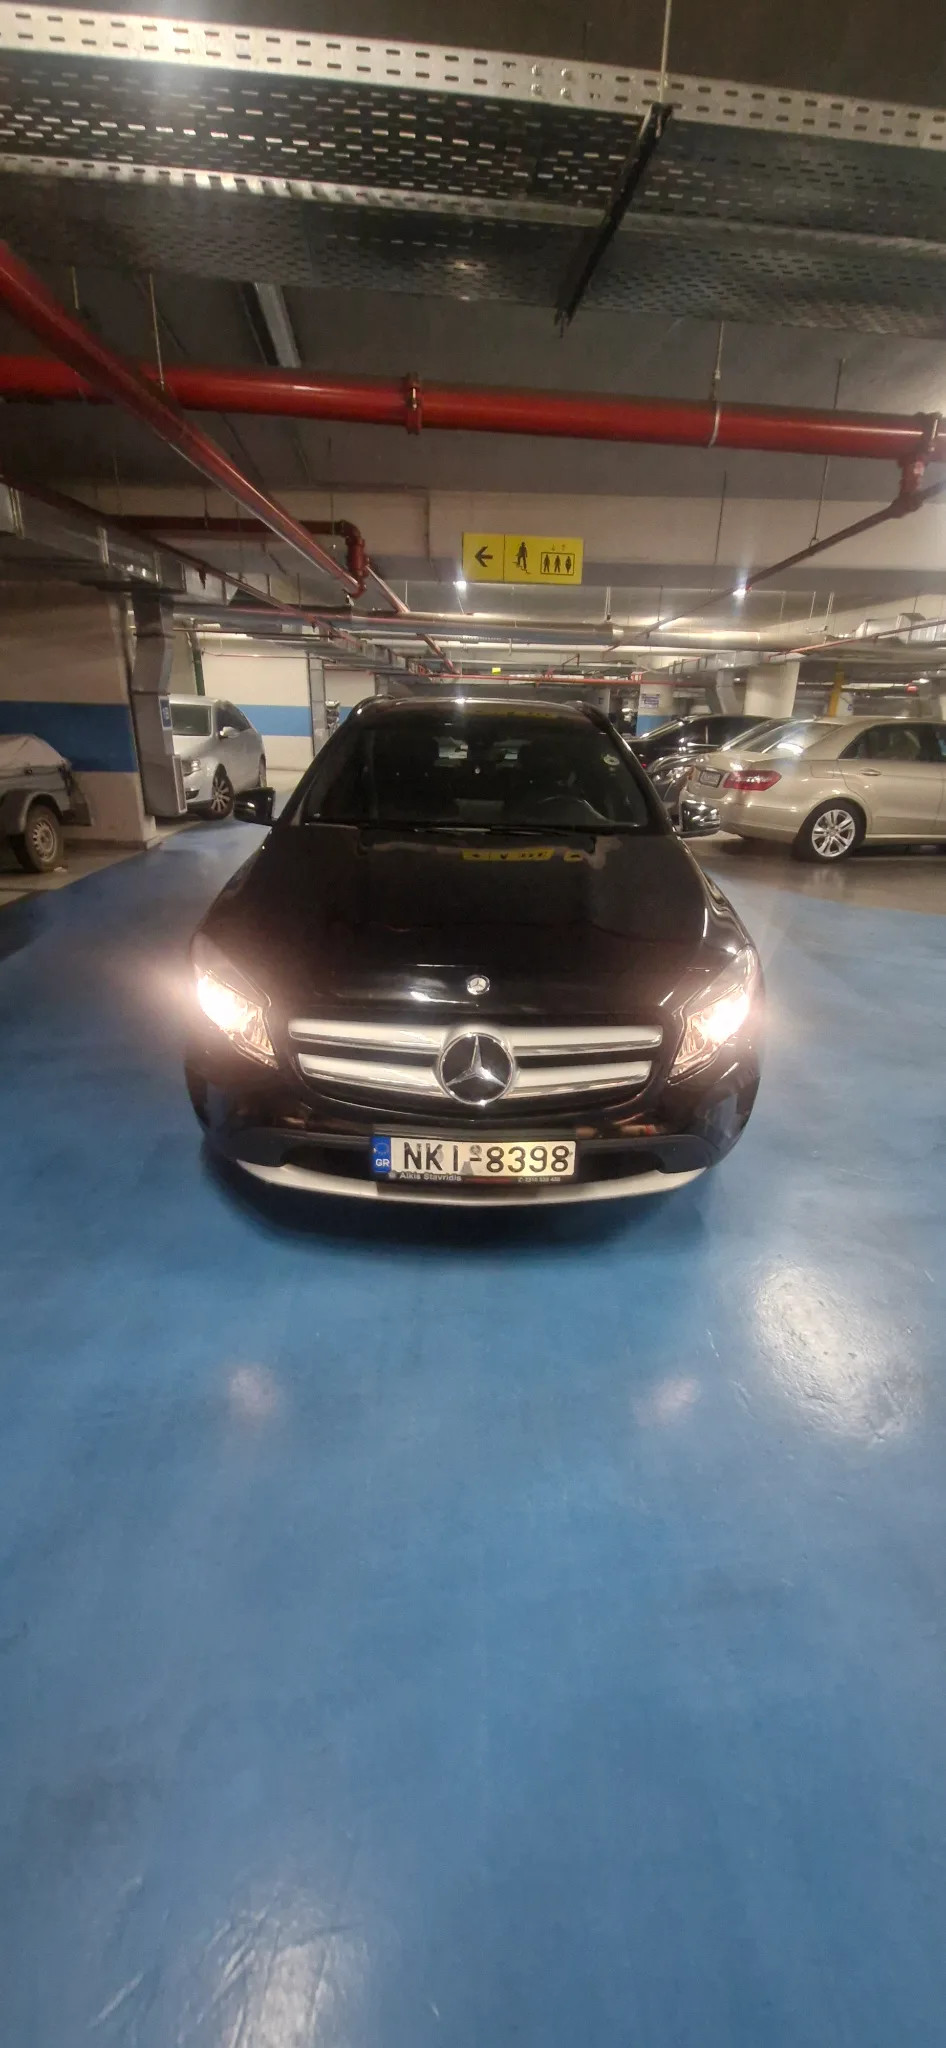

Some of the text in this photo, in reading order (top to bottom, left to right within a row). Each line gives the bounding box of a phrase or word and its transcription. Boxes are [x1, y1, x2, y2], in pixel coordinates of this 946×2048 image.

[375, 1158, 390, 1167] GR
[404, 1142, 569, 1173] NKI-8398
[423, 1172, 462, 1182] Stavridis
